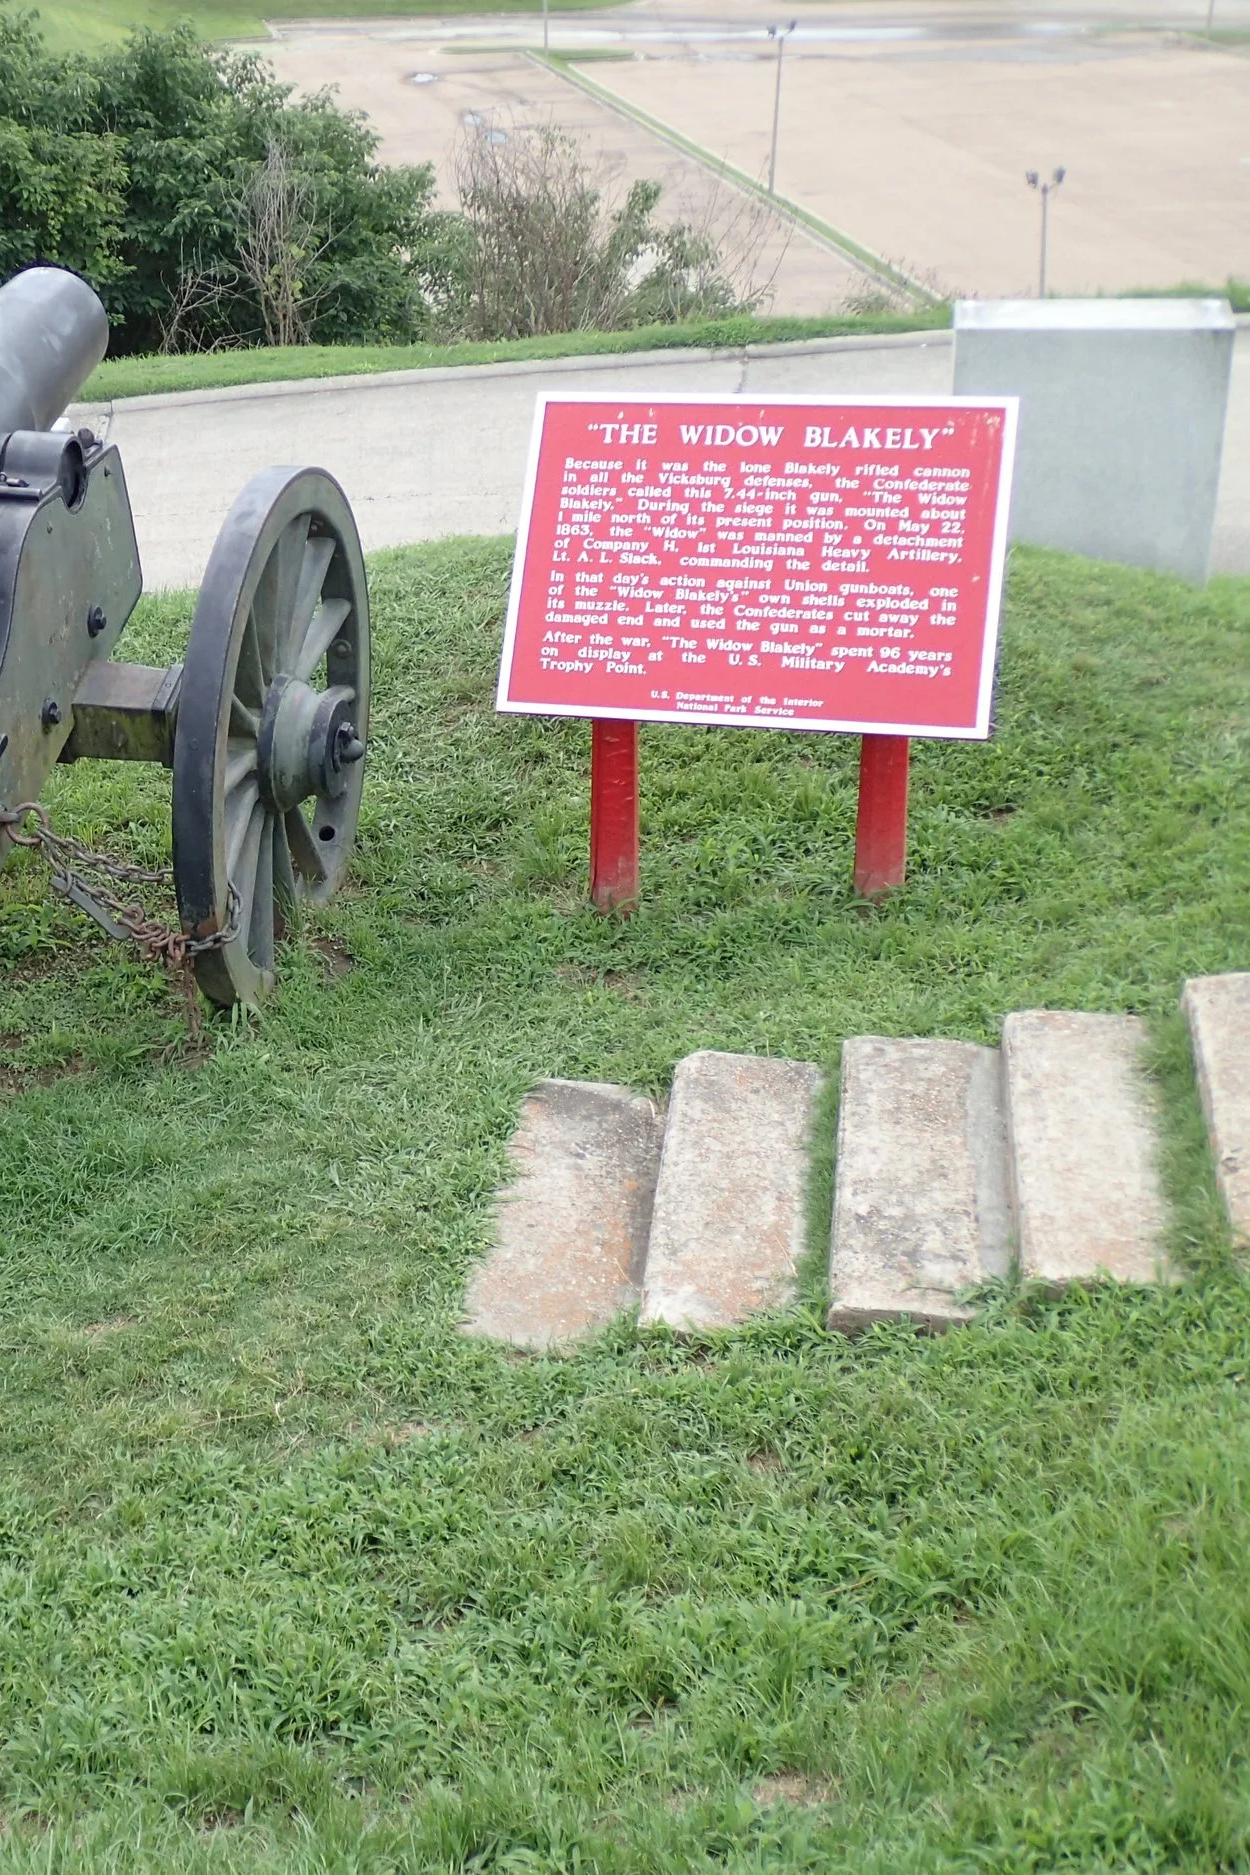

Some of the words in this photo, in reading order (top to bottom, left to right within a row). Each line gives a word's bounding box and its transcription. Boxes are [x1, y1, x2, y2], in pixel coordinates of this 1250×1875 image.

[679, 424, 785, 446] WIDOW
[564, 457, 623, 470] Because
[635, 458, 647, 471] it
[661, 462, 689, 472] was
[702, 460, 727, 472] the
[739, 461, 772, 473] lone
[783, 461, 841, 479] Blakely
[854, 463, 899, 476] rifled
[913, 467, 970, 478] cannon
[563, 470, 577, 482] in
[590, 471, 608, 483] all
[621, 471, 644, 483] the
[658, 472, 731, 490] Vicksburg
[834, 476, 860, 489] the
[873, 478, 970, 492] Confederate
[560, 484, 617, 496] soldiers
[627, 485, 671, 497] called
[684, 487, 711, 498] this
[918, 492, 967, 505] Widow
[637, 498, 689, 515] During
[701, 501, 725, 513] the
[734, 501, 773, 516] siege
[784, 502, 797, 515] it
[806, 506, 834, 516] was
[844, 506, 909, 518] mounted
[920, 508, 966, 519] about
[572, 510, 601, 523] mile
[610, 512, 651, 524] north
[661, 513, 677, 524] of
[686, 513, 705, 526] its
[715, 515, 772, 528] present
[782, 517, 848, 530] position.
[863, 518, 885, 530] On
[899, 519, 929, 535] May
[609, 525, 633, 536] the
[717, 531, 744, 541] was
[754, 531, 813, 543] manned
[823, 532, 842, 547] by
[852, 535, 862, 544] a
[872, 533, 963, 547] detachment
[552, 549, 570, 562] Lt.
[576, 550, 593, 562] A.
[599, 551, 613, 563] L.
[679, 556, 774, 572] commanding
[785, 558, 811, 570] the
[821, 559, 870, 572] detail.
[553, 537, 570, 549] of
[581, 537, 649, 554] Company
[732, 542, 805, 556] Louisiana
[821, 545, 871, 562] Heavy
[886, 547, 962, 565] Artillery.
[549, 569, 564, 582] In
[575, 571, 604, 583] that
[611, 572, 649, 588] day's
[659, 574, 705, 587] action
[715, 576, 772, 592] against
[784, 578, 828, 592] Union
[928, 587, 959, 597] one
[547, 583, 564, 595] of
[574, 585, 598, 596] the
[758, 593, 790, 604] own
[802, 593, 846, 606] shells
[856, 597, 929, 610] exploded
[940, 598, 957, 611] in
[546, 596, 565, 609] its
[574, 599, 629, 611] muzzle.
[700, 603, 723, 615] the
[733, 604, 833, 620] Confederates
[843, 610, 869, 621] cut
[879, 613, 919, 626] away
[929, 613, 957, 625] the
[544, 610, 608, 626] damaged
[616, 614, 644, 626] end
[653, 615, 681, 627] and
[690, 617, 726, 630] used
[735, 618, 760, 631] the
[769, 622, 798, 635] gun
[808, 624, 826, 634] as
[836, 625, 847, 635] a
[856, 624, 915, 638] mortar.
[542, 630, 582, 643] After
[589, 633, 613, 645] the
[706, 638, 753, 651] Widow
[830, 646, 874, 658] spent
[879, 646, 901, 658] 96
[907, 650, 953, 662] years
[539, 657, 594, 674] Trophy
[605, 660, 647, 675] Point.
[540, 646, 558, 656] on
[576, 646, 631, 664] display
[647, 650, 663, 662] at
[681, 651, 706, 663] the
[780, 655, 845, 673] Military
[866, 659, 951, 678] Academy's
[675, 691, 734, 702] Department
[740, 695, 753, 703] of
[759, 695, 776, 705] the
[783, 697, 824, 707] Interior
[676, 701, 718, 711] National
[723, 703, 747, 713] Park
[753, 705, 794, 716] Service
